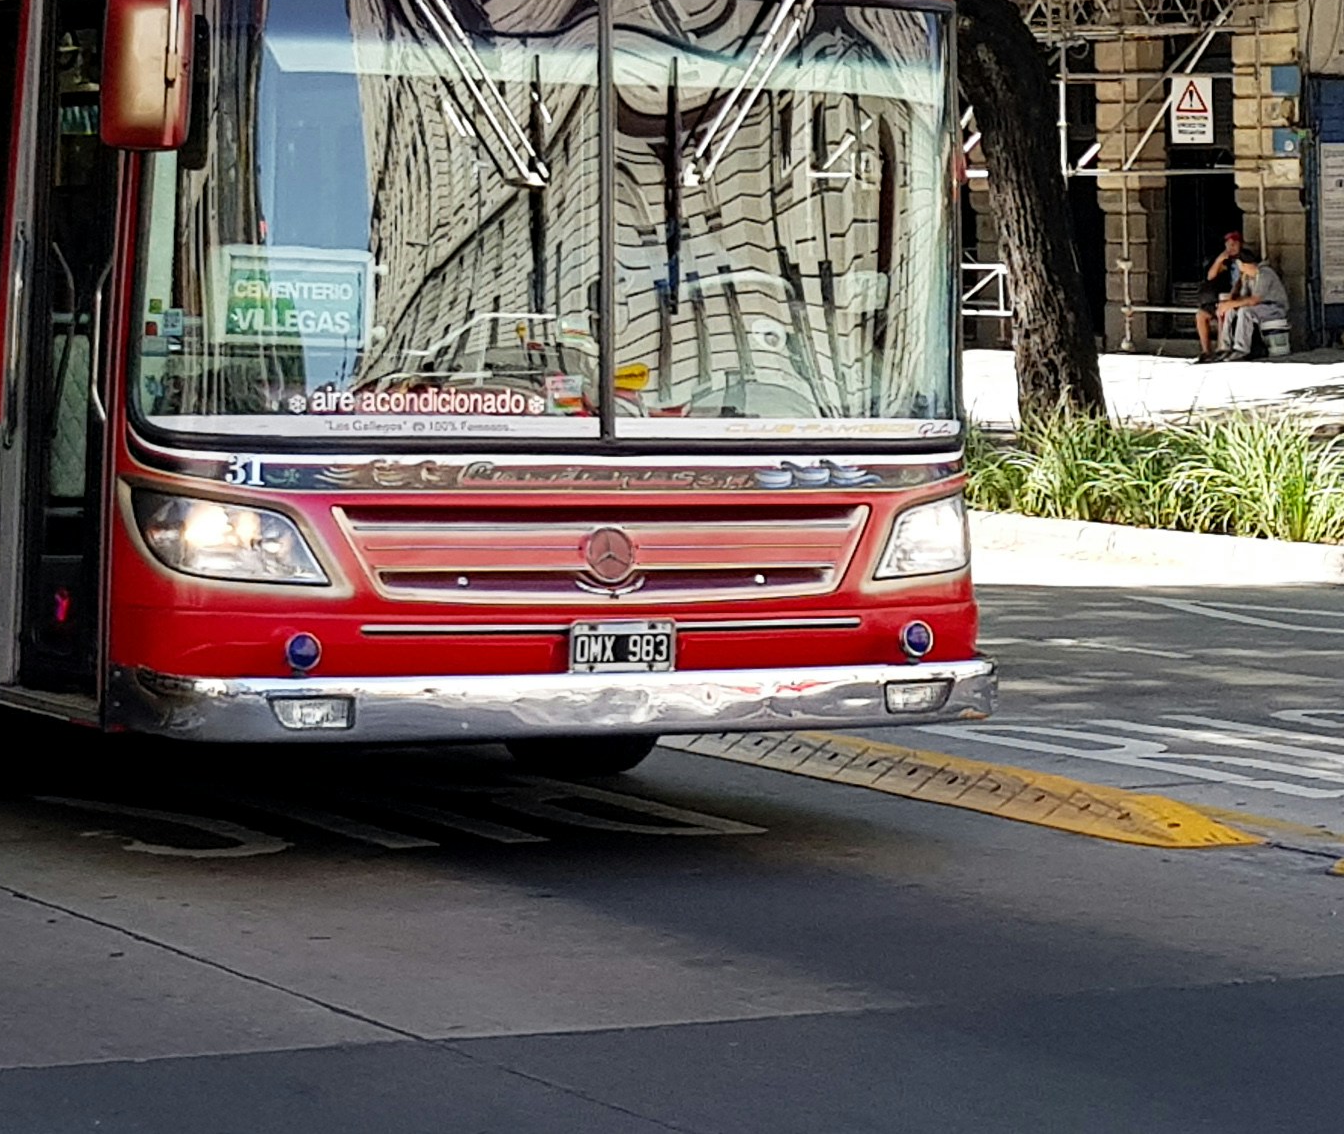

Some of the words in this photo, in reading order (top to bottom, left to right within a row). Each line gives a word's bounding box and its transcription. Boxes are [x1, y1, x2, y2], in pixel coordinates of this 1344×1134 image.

[234, 279, 353, 301] CEMENTERIO
[236, 307, 351, 334] VILLEGAS
[312, 386, 354, 412] aire
[362, 388, 525, 414] acondicionado
[225, 454, 265, 486] 31
[577, 636, 615, 662] OMX
[628, 635, 668, 661] 983
